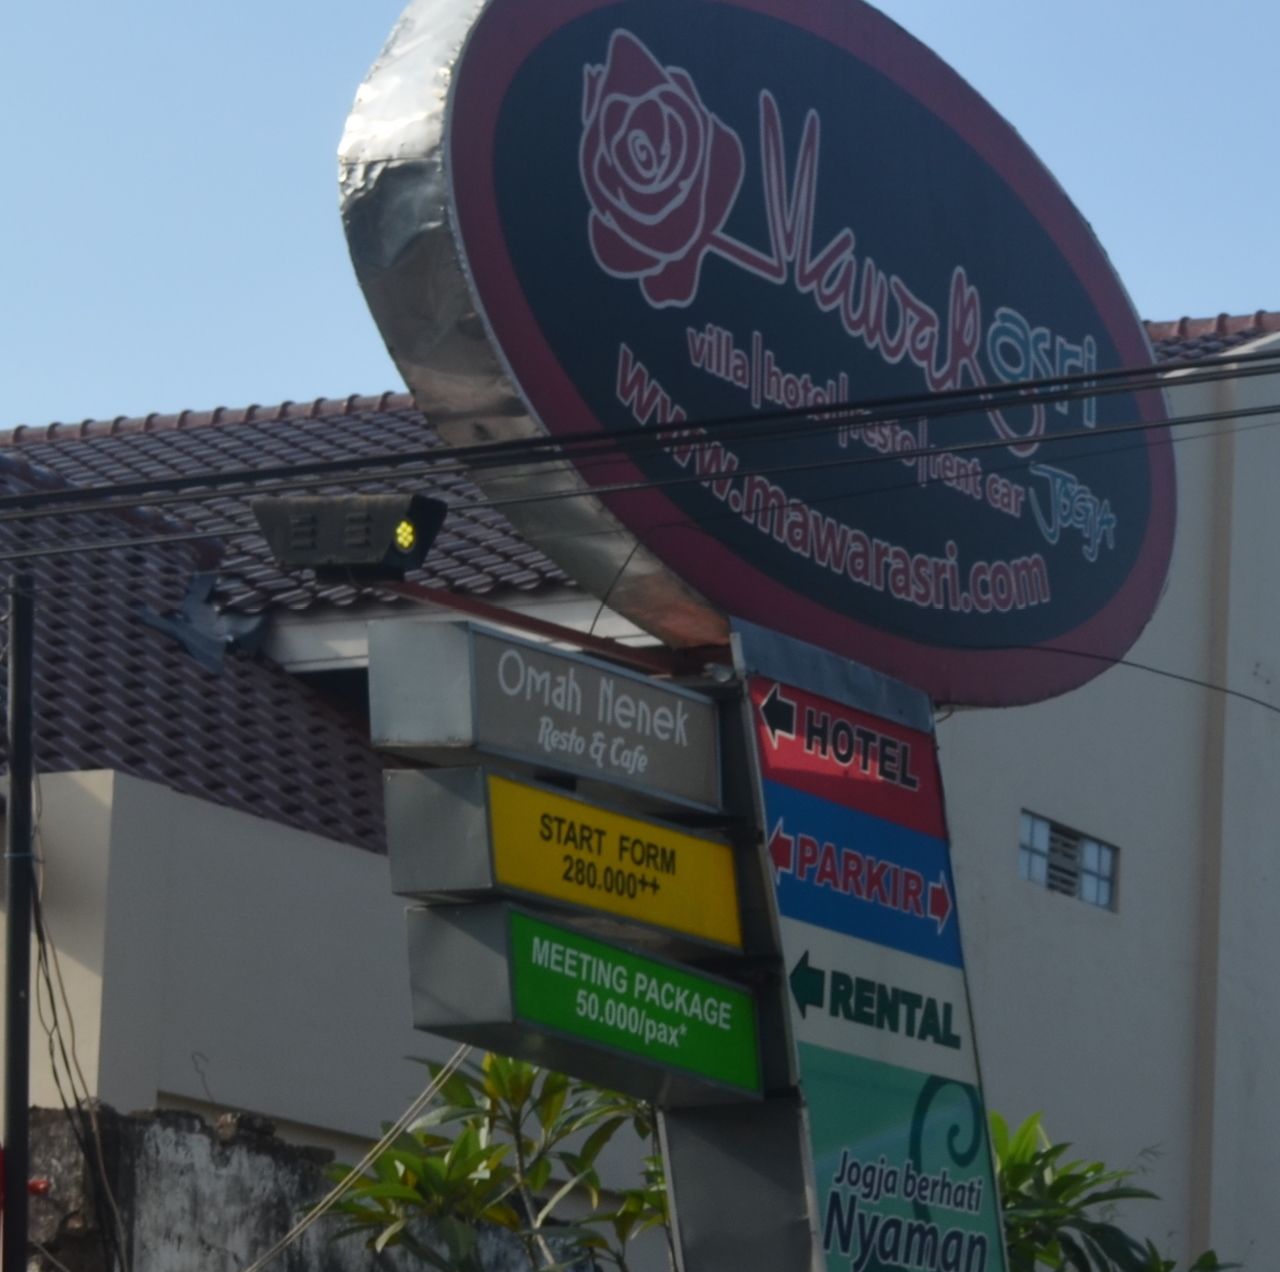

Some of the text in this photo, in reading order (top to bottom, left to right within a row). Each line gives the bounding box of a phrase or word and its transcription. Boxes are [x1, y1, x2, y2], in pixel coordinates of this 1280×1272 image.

[616, 342, 1049, 612] www.mawarasri.com
[986, 469, 1026, 518] car
[498, 649, 581, 717] Omah
[538, 716, 648, 775] Resto & Cafe
[803, 708, 919, 791] HOTEL
[539, 812, 676, 876] START FORM
[562, 855, 660, 900] 280.000++
[796, 836, 924, 916] PARKIR
[531, 936, 732, 1030] MEETING PACKAGE
[829, 972, 961, 1050] RENTAL
[834, 1149, 983, 1216] Jogja berhati
